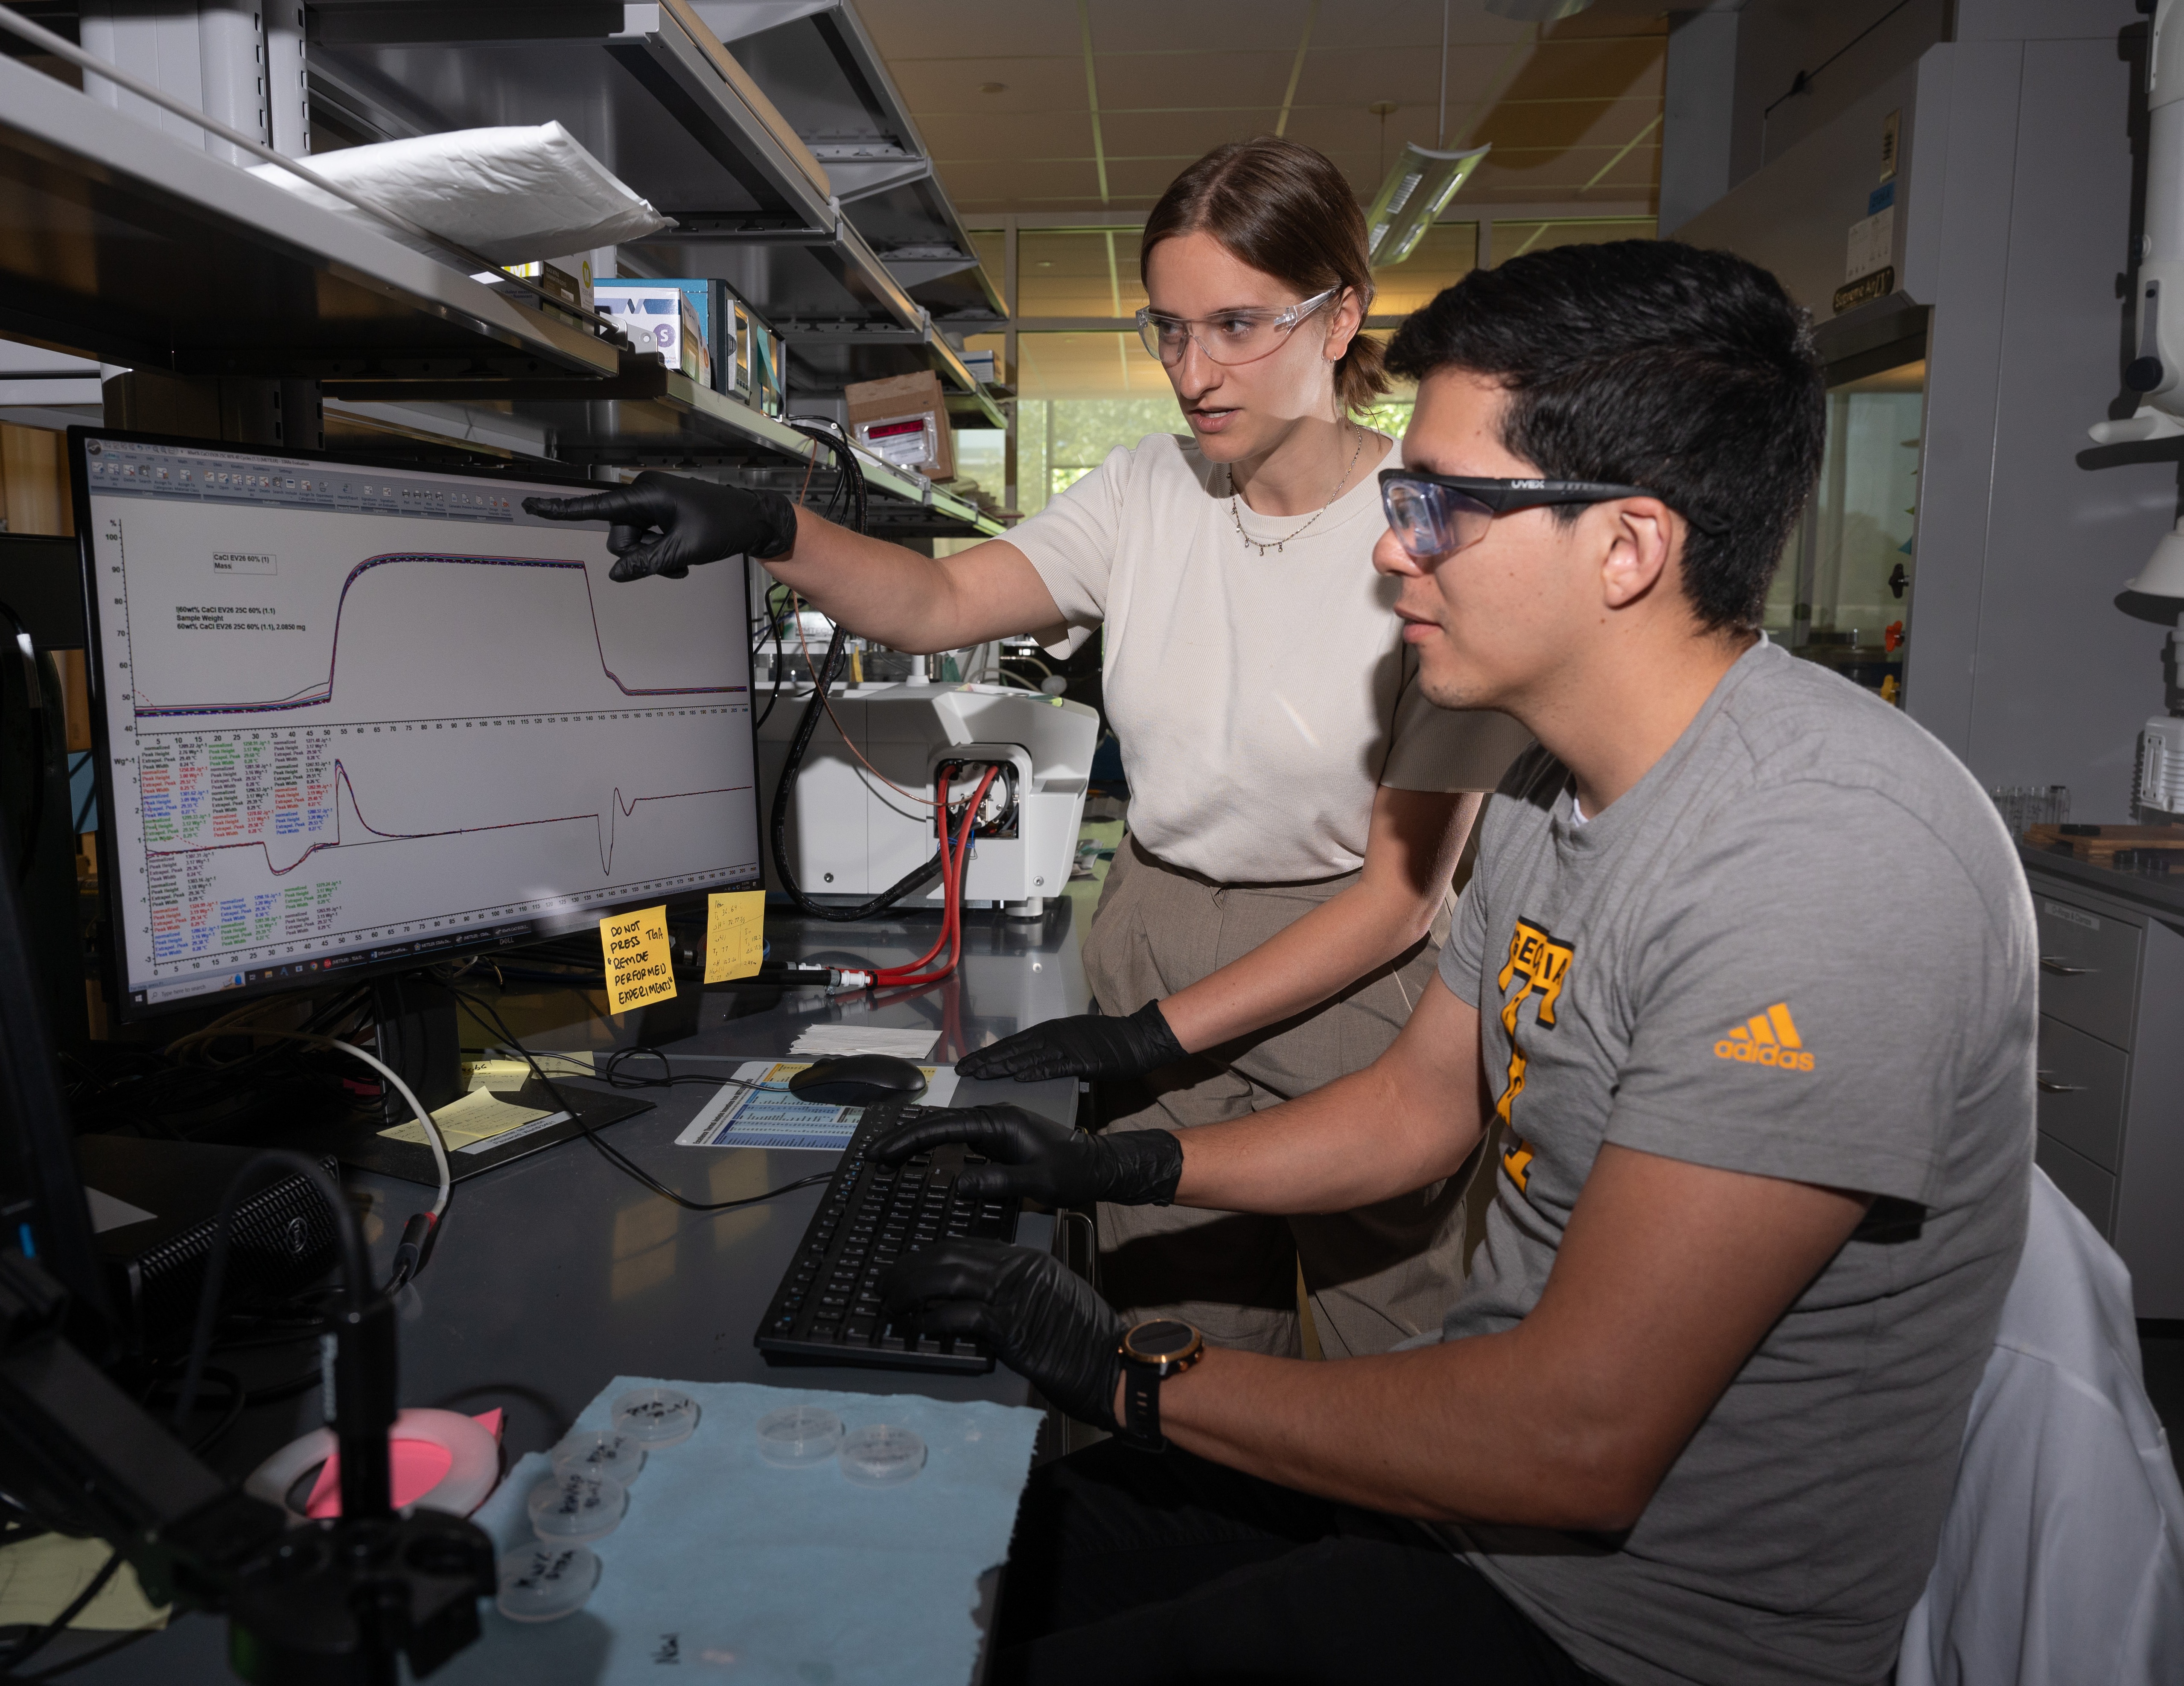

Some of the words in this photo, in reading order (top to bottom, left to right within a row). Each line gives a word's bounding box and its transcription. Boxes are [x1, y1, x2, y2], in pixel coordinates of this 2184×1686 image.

[660, 329, 669, 342] S
[610, 926, 622, 937] DO
[624, 920, 640, 934] NOT
[499, 937, 514, 945] DELL
[610, 936, 640, 954] PRESS
[645, 927, 663, 940] TGA
[230, 955, 239, 963] 20
[249, 952, 258, 960] 25
[615, 963, 666, 986] PERFORMED
[1715, 1037, 1814, 1072] adidas
